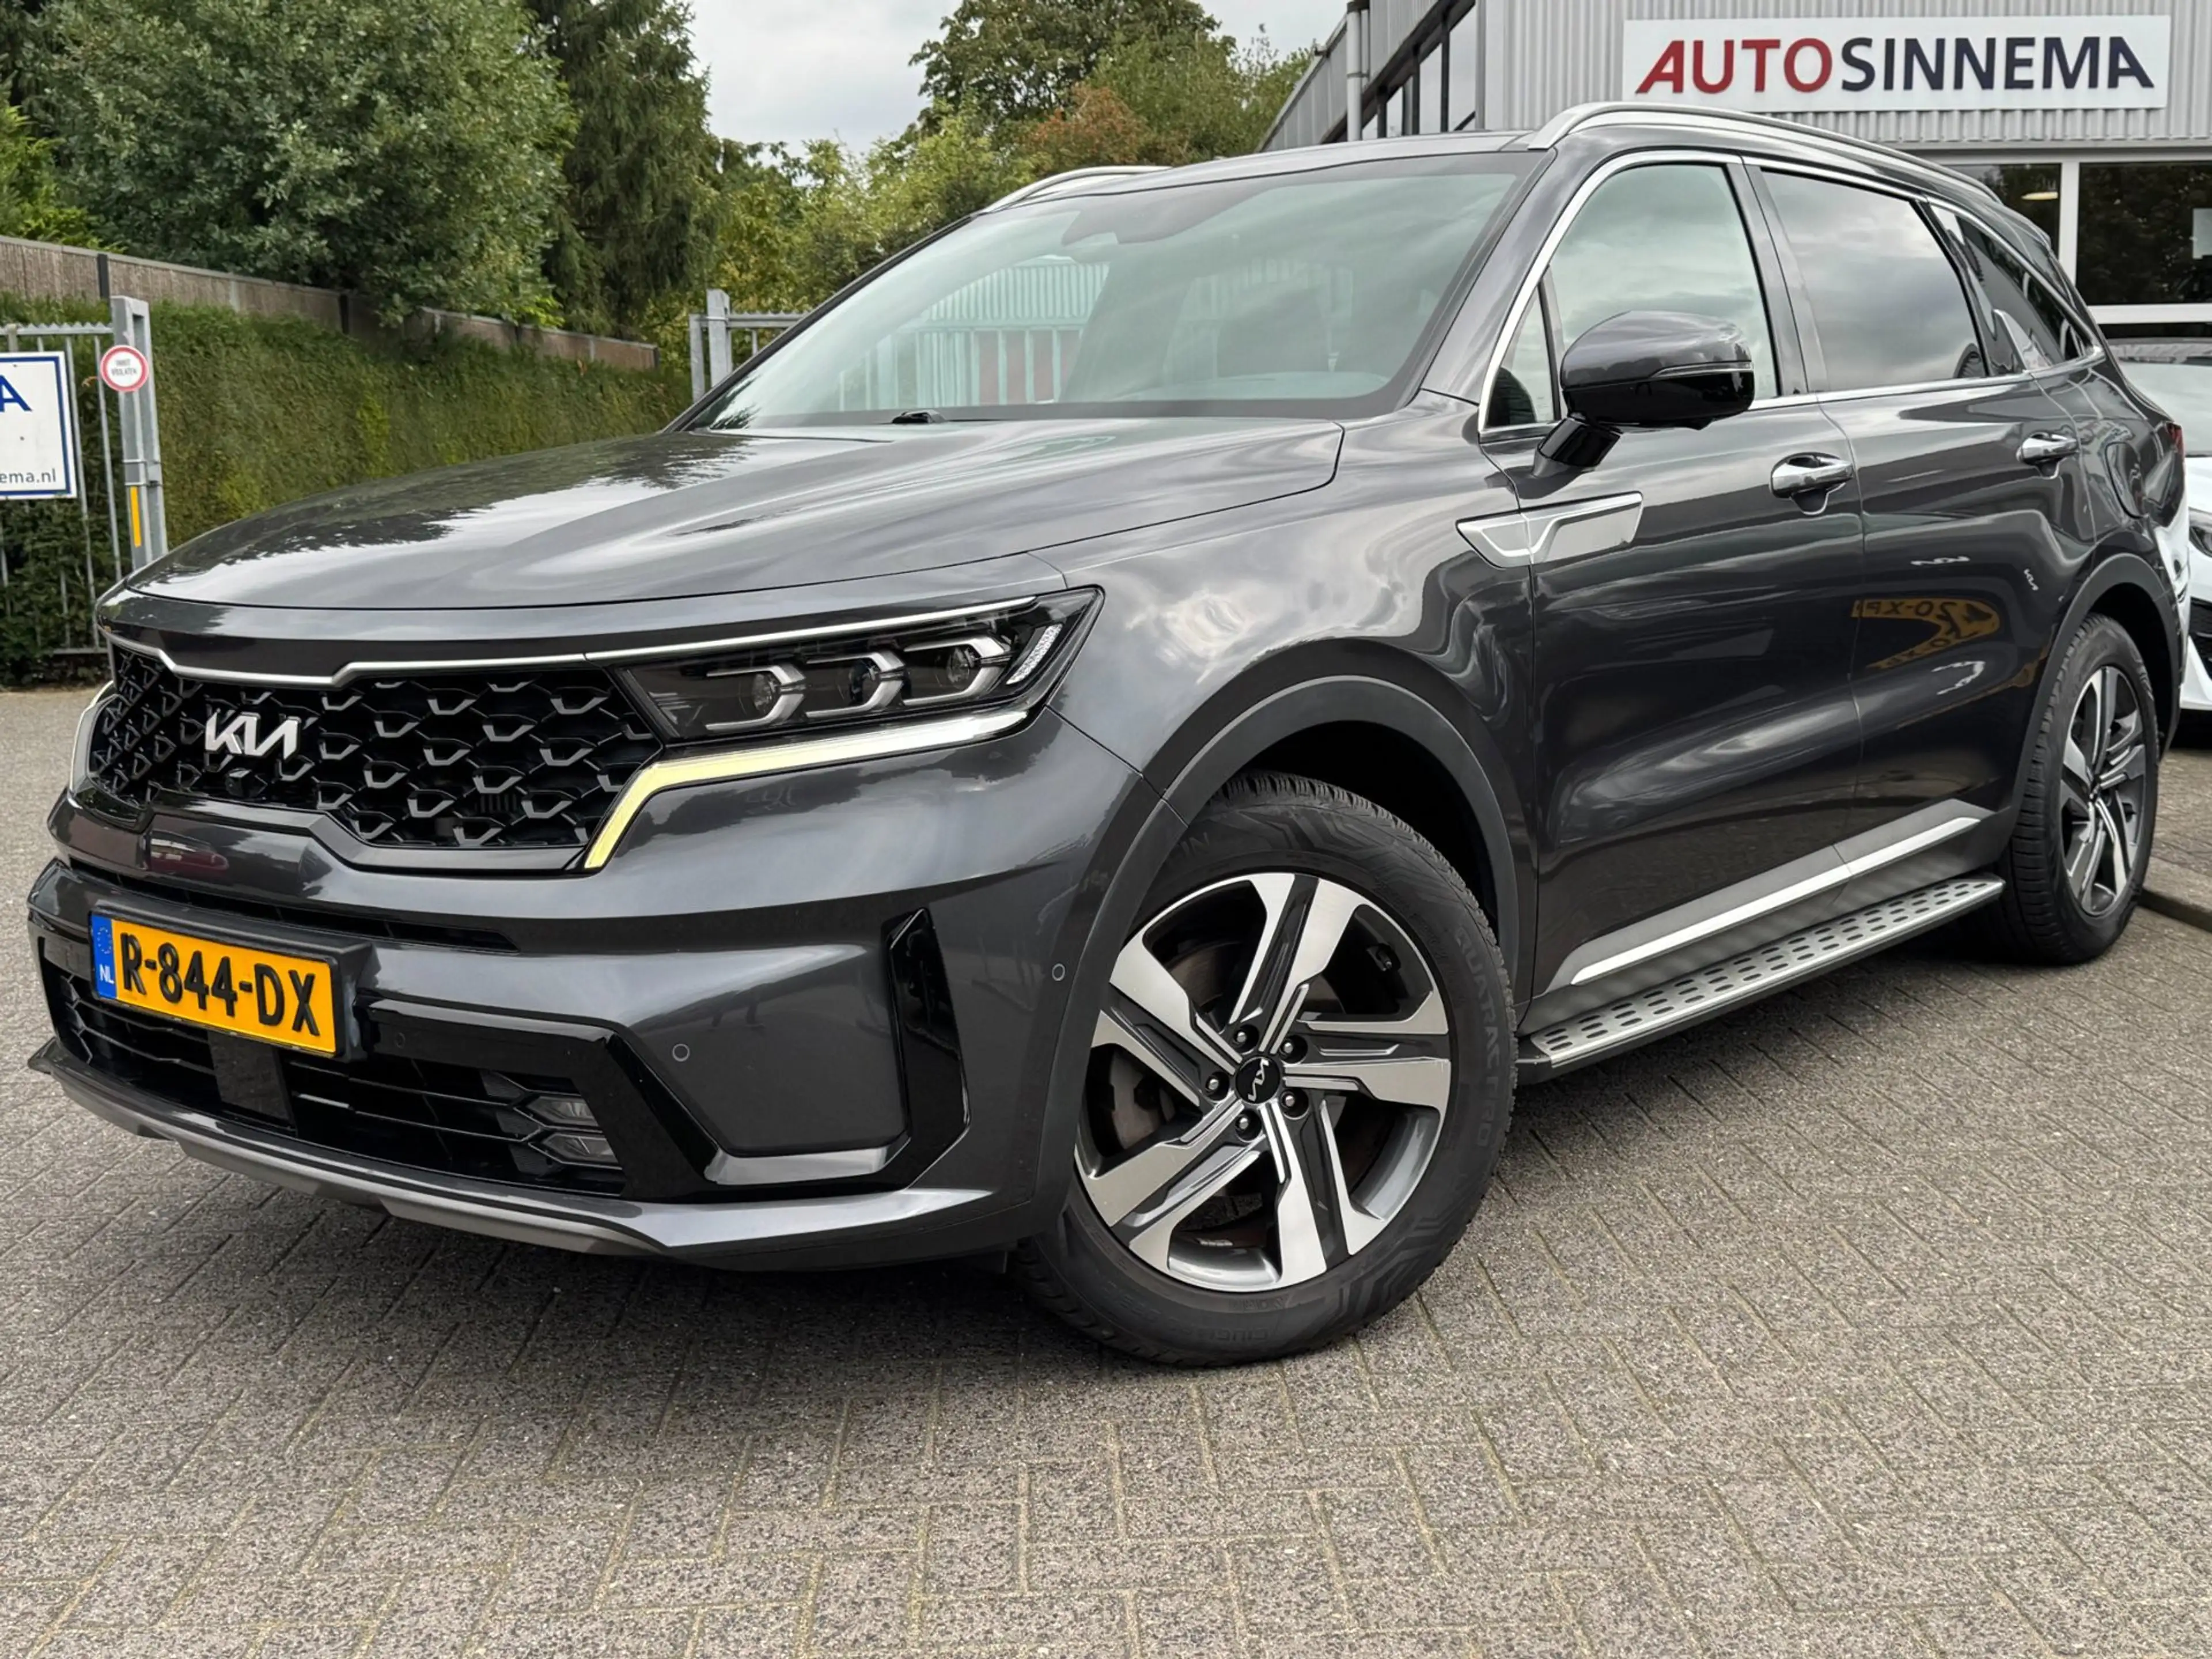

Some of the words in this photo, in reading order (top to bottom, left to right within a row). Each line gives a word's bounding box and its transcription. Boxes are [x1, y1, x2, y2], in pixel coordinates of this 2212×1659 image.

[1635, 36, 2155, 94] AUTOSINNEMA
[204, 711, 302, 760] KIA
[99, 963, 115, 984] NL
[120, 932, 320, 1036] R-844-DX
